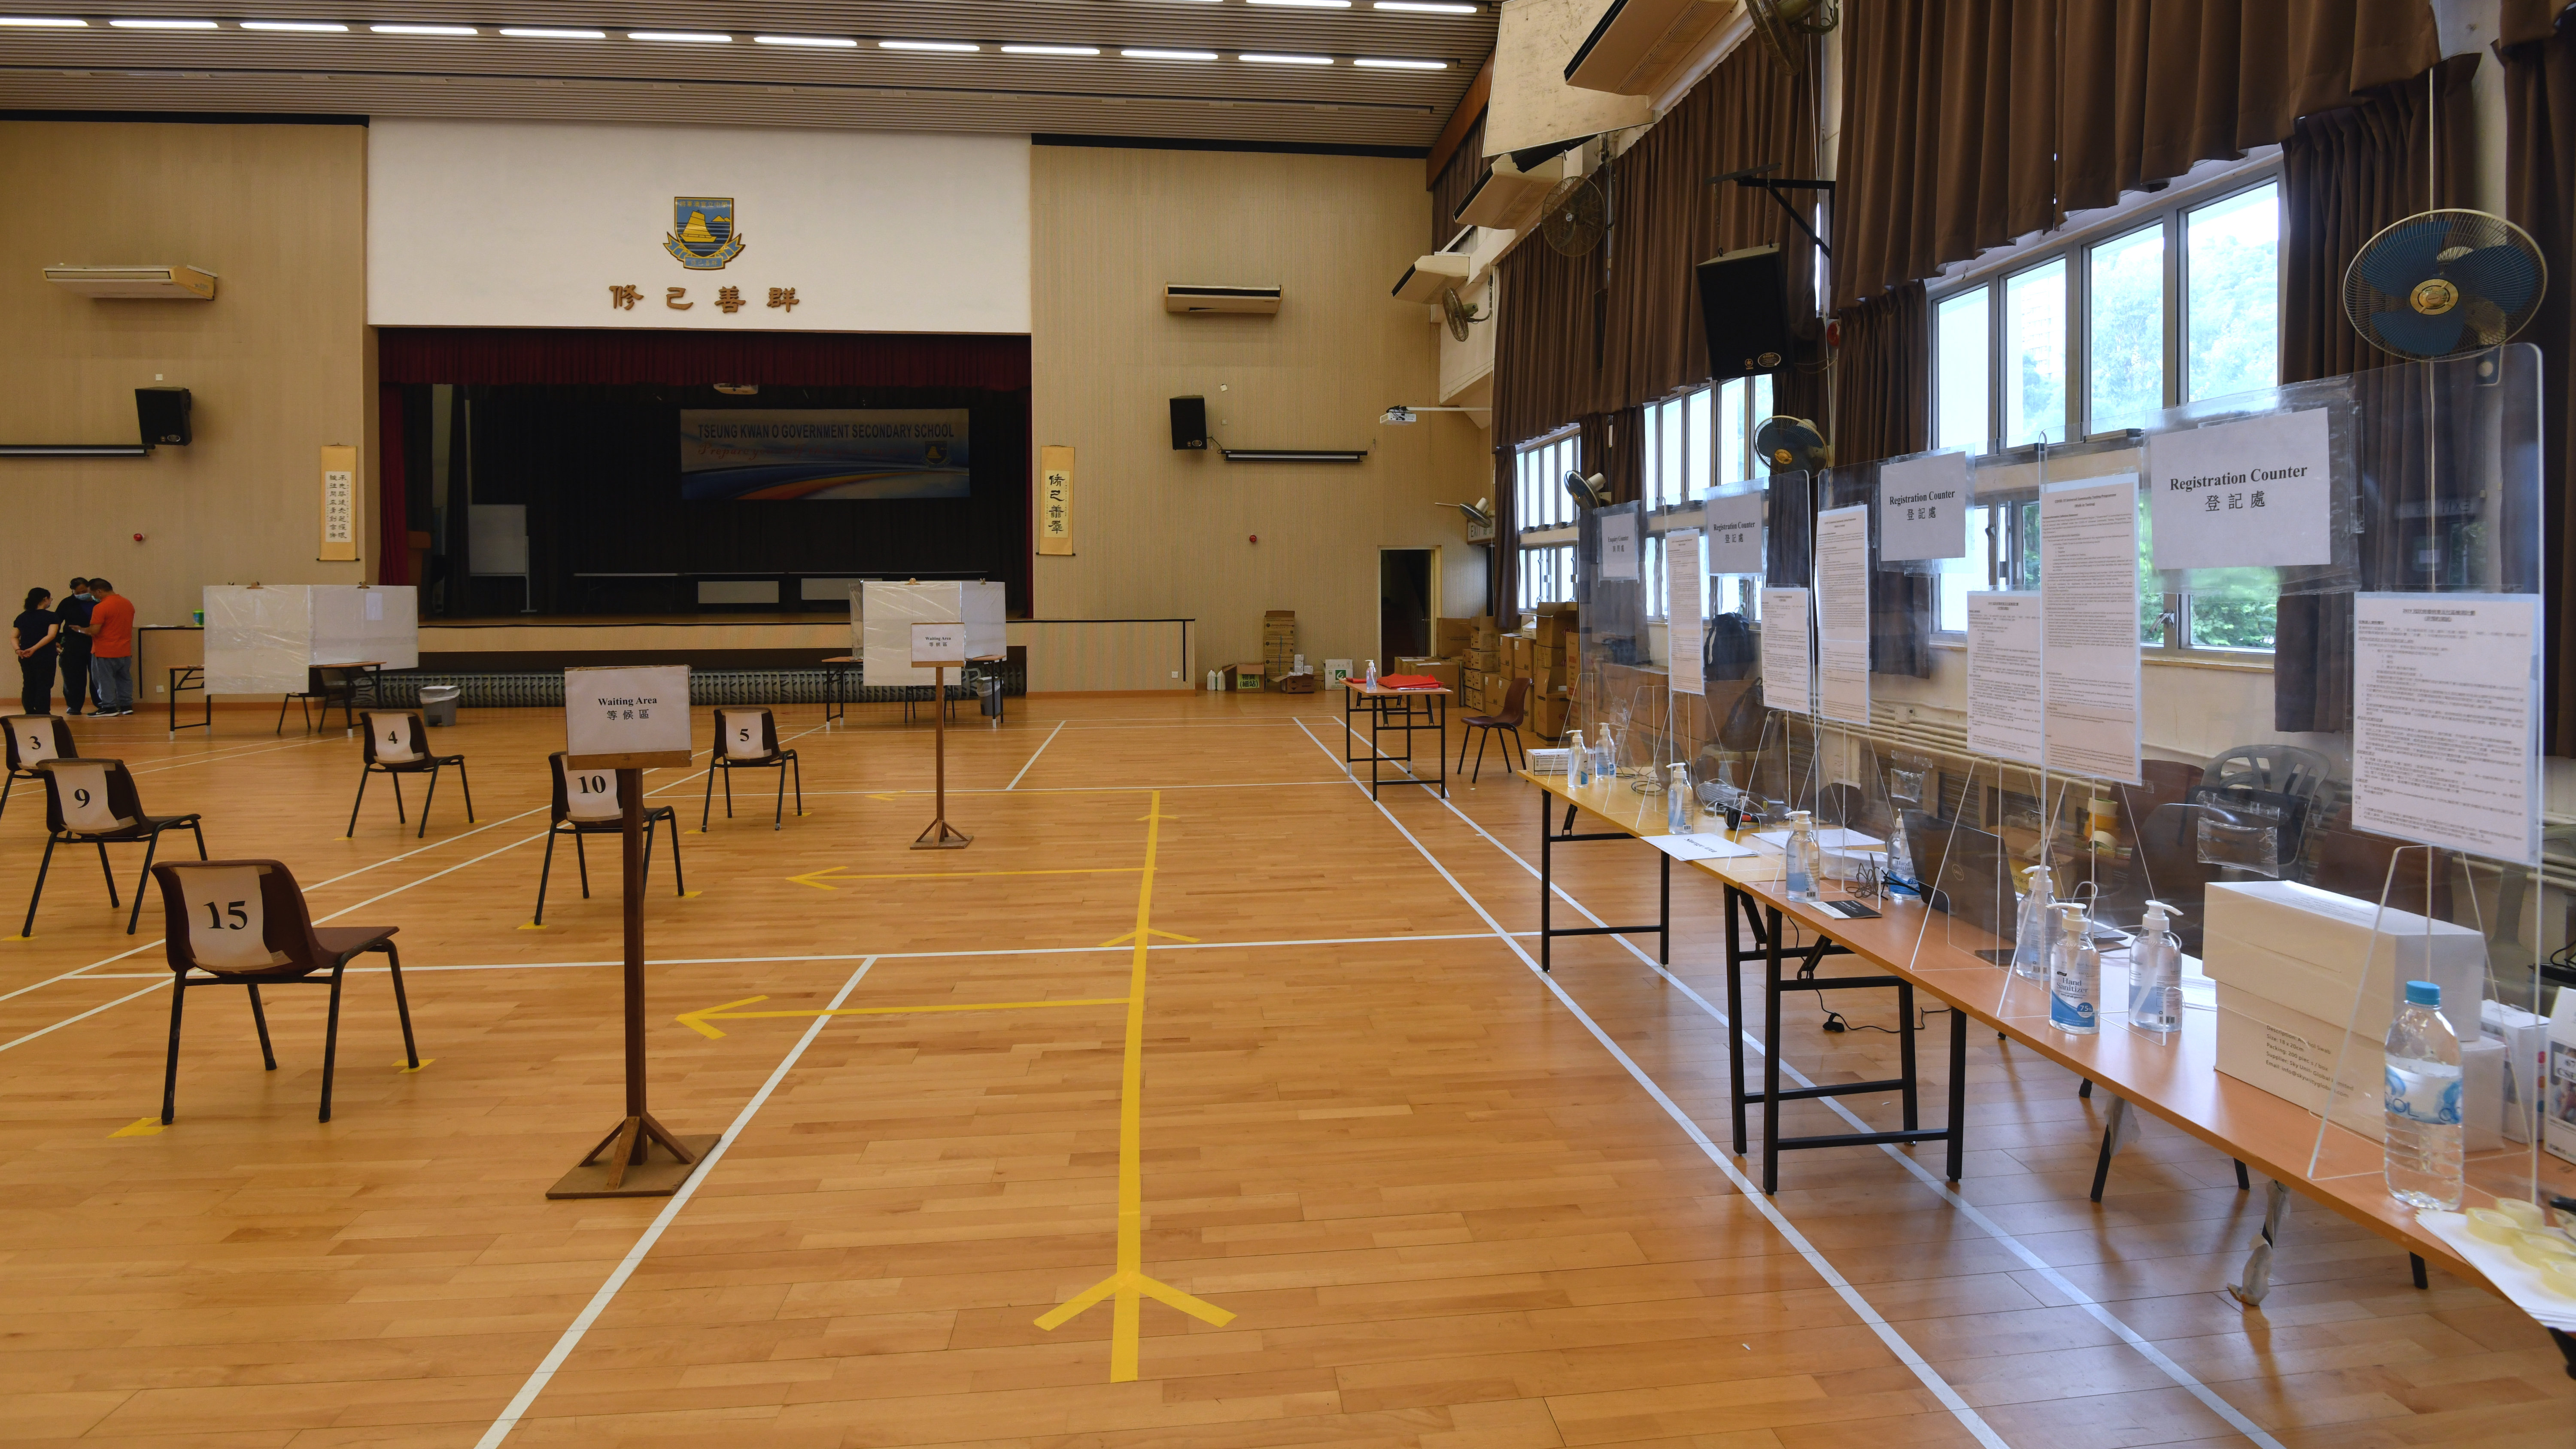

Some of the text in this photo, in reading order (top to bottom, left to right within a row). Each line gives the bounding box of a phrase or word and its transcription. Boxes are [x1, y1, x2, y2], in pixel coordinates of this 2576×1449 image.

[609, 284, 800, 313] 修己善群
[698, 423, 954, 439] TSEUNG KWAN O GOVERNMENT SECONDARY SCHOOL
[698, 441, 749, 459] Prepare
[809, 442, 832, 455] that
[2170, 465, 2308, 493] Registration Counter
[1889, 489, 1955, 507] Registration Counter
[2205, 490, 2266, 512] 登記處
[1906, 506, 1936, 521] 登記處
[1713, 521, 1756, 532] Registration Counter
[1725, 533, 1744, 544] 登記處
[598, 696, 657, 707] Waiting Area
[607, 709, 650, 721] 等候區
[30, 736, 41, 750] 3
[388, 731, 398, 744] 4
[740, 729, 749, 742] 5
[577, 775, 607, 794] 10
[74, 789, 91, 808] 9
[204, 900, 248, 930] 15
[2057, 982, 2088, 993] Sanitizer
[2063, 977, 2082, 986] Hand
[2266, 1025, 2297, 1041] Description:
[2317, 1045, 2331, 1054] Swab
[2290, 1043, 2304, 1052] 20cm
[2266, 1042, 2287, 1055] Packing:
[2298, 1056, 2314, 1066] piecs
[2318, 1063, 2328, 1072] box
[2266, 1060, 2280, 1069] Email:
[2266, 1051, 2289, 1064] Supplier:
[2289, 1060, 2299, 1069] Sky
[2313, 1071, 2330, 1082] Global
